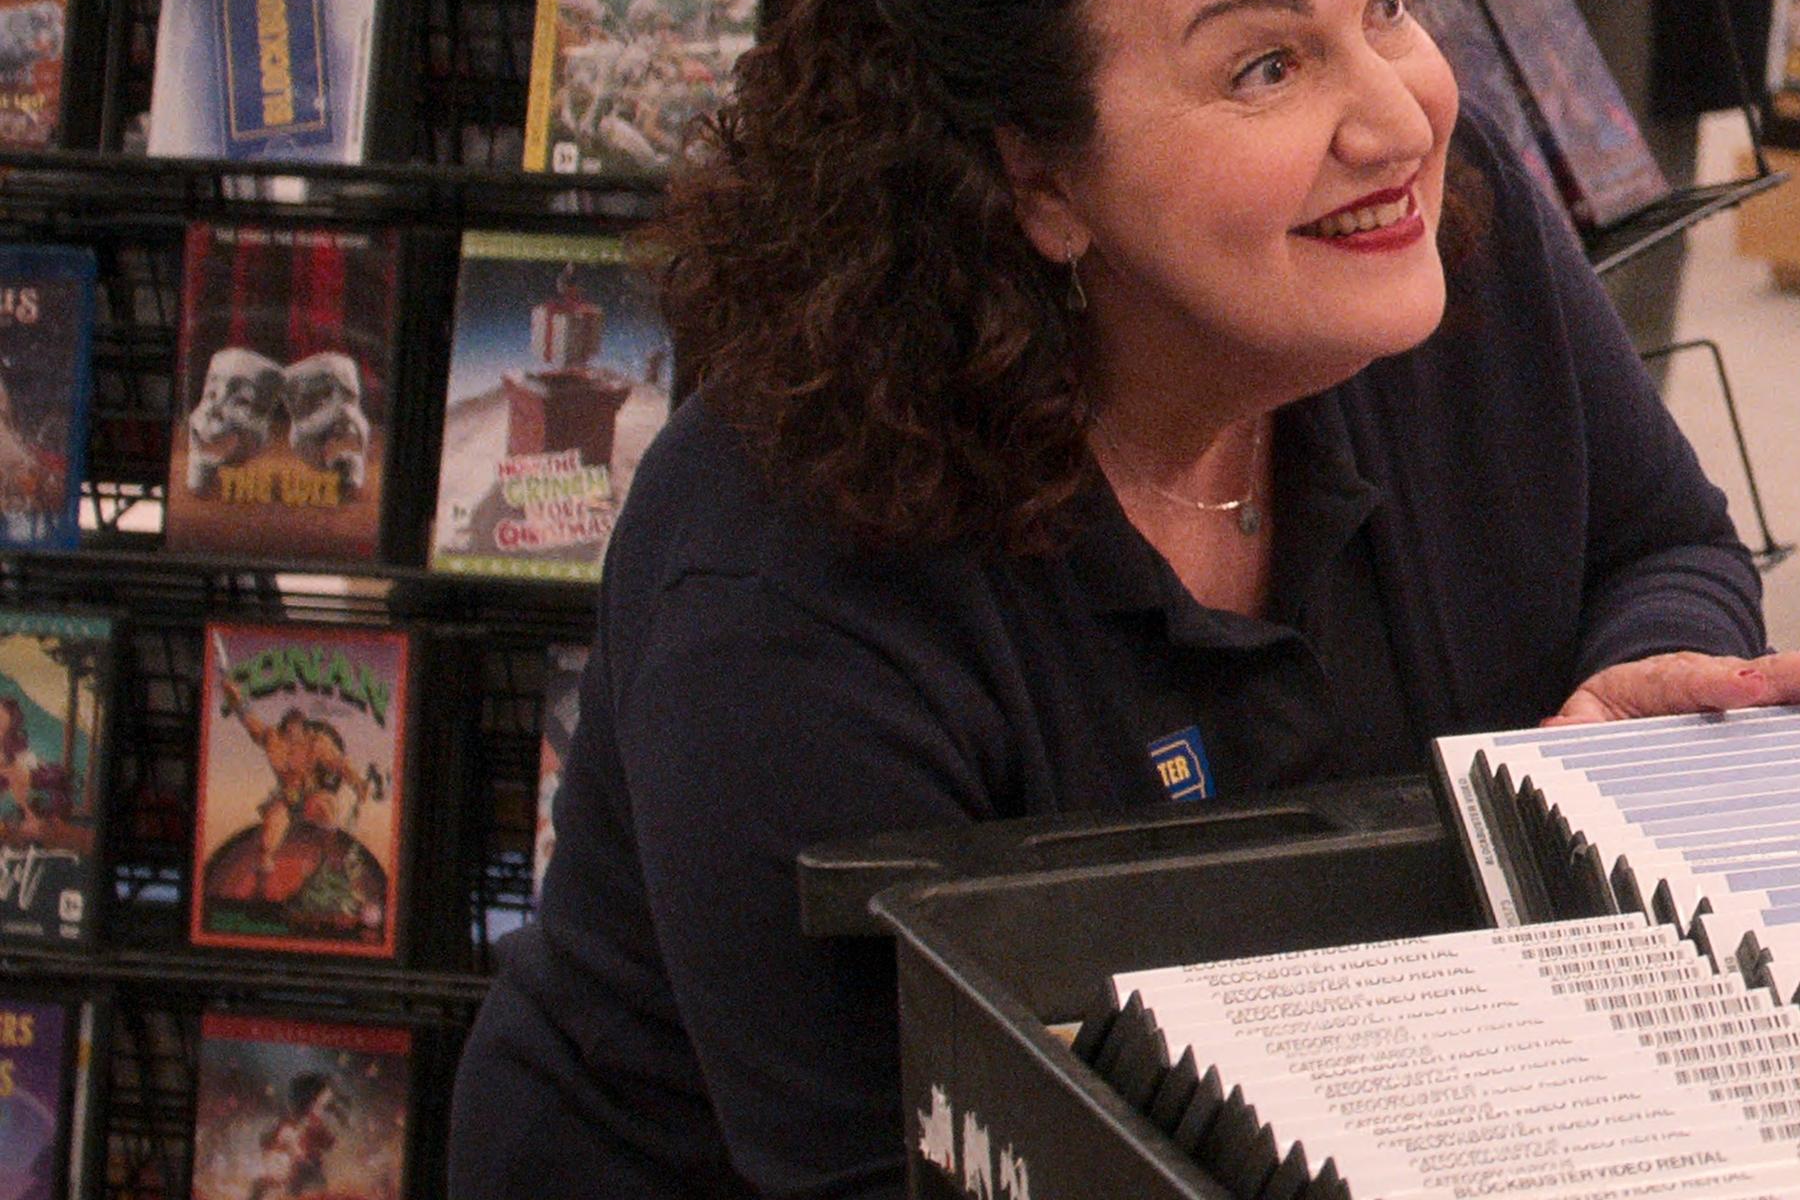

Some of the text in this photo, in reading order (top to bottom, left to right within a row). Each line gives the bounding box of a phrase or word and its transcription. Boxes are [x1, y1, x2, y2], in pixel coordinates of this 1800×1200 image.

[1157, 756, 1191, 787] TER
[1453, 1149, 1727, 1199] BLOCKBUSTER VIDEO RENTAL
